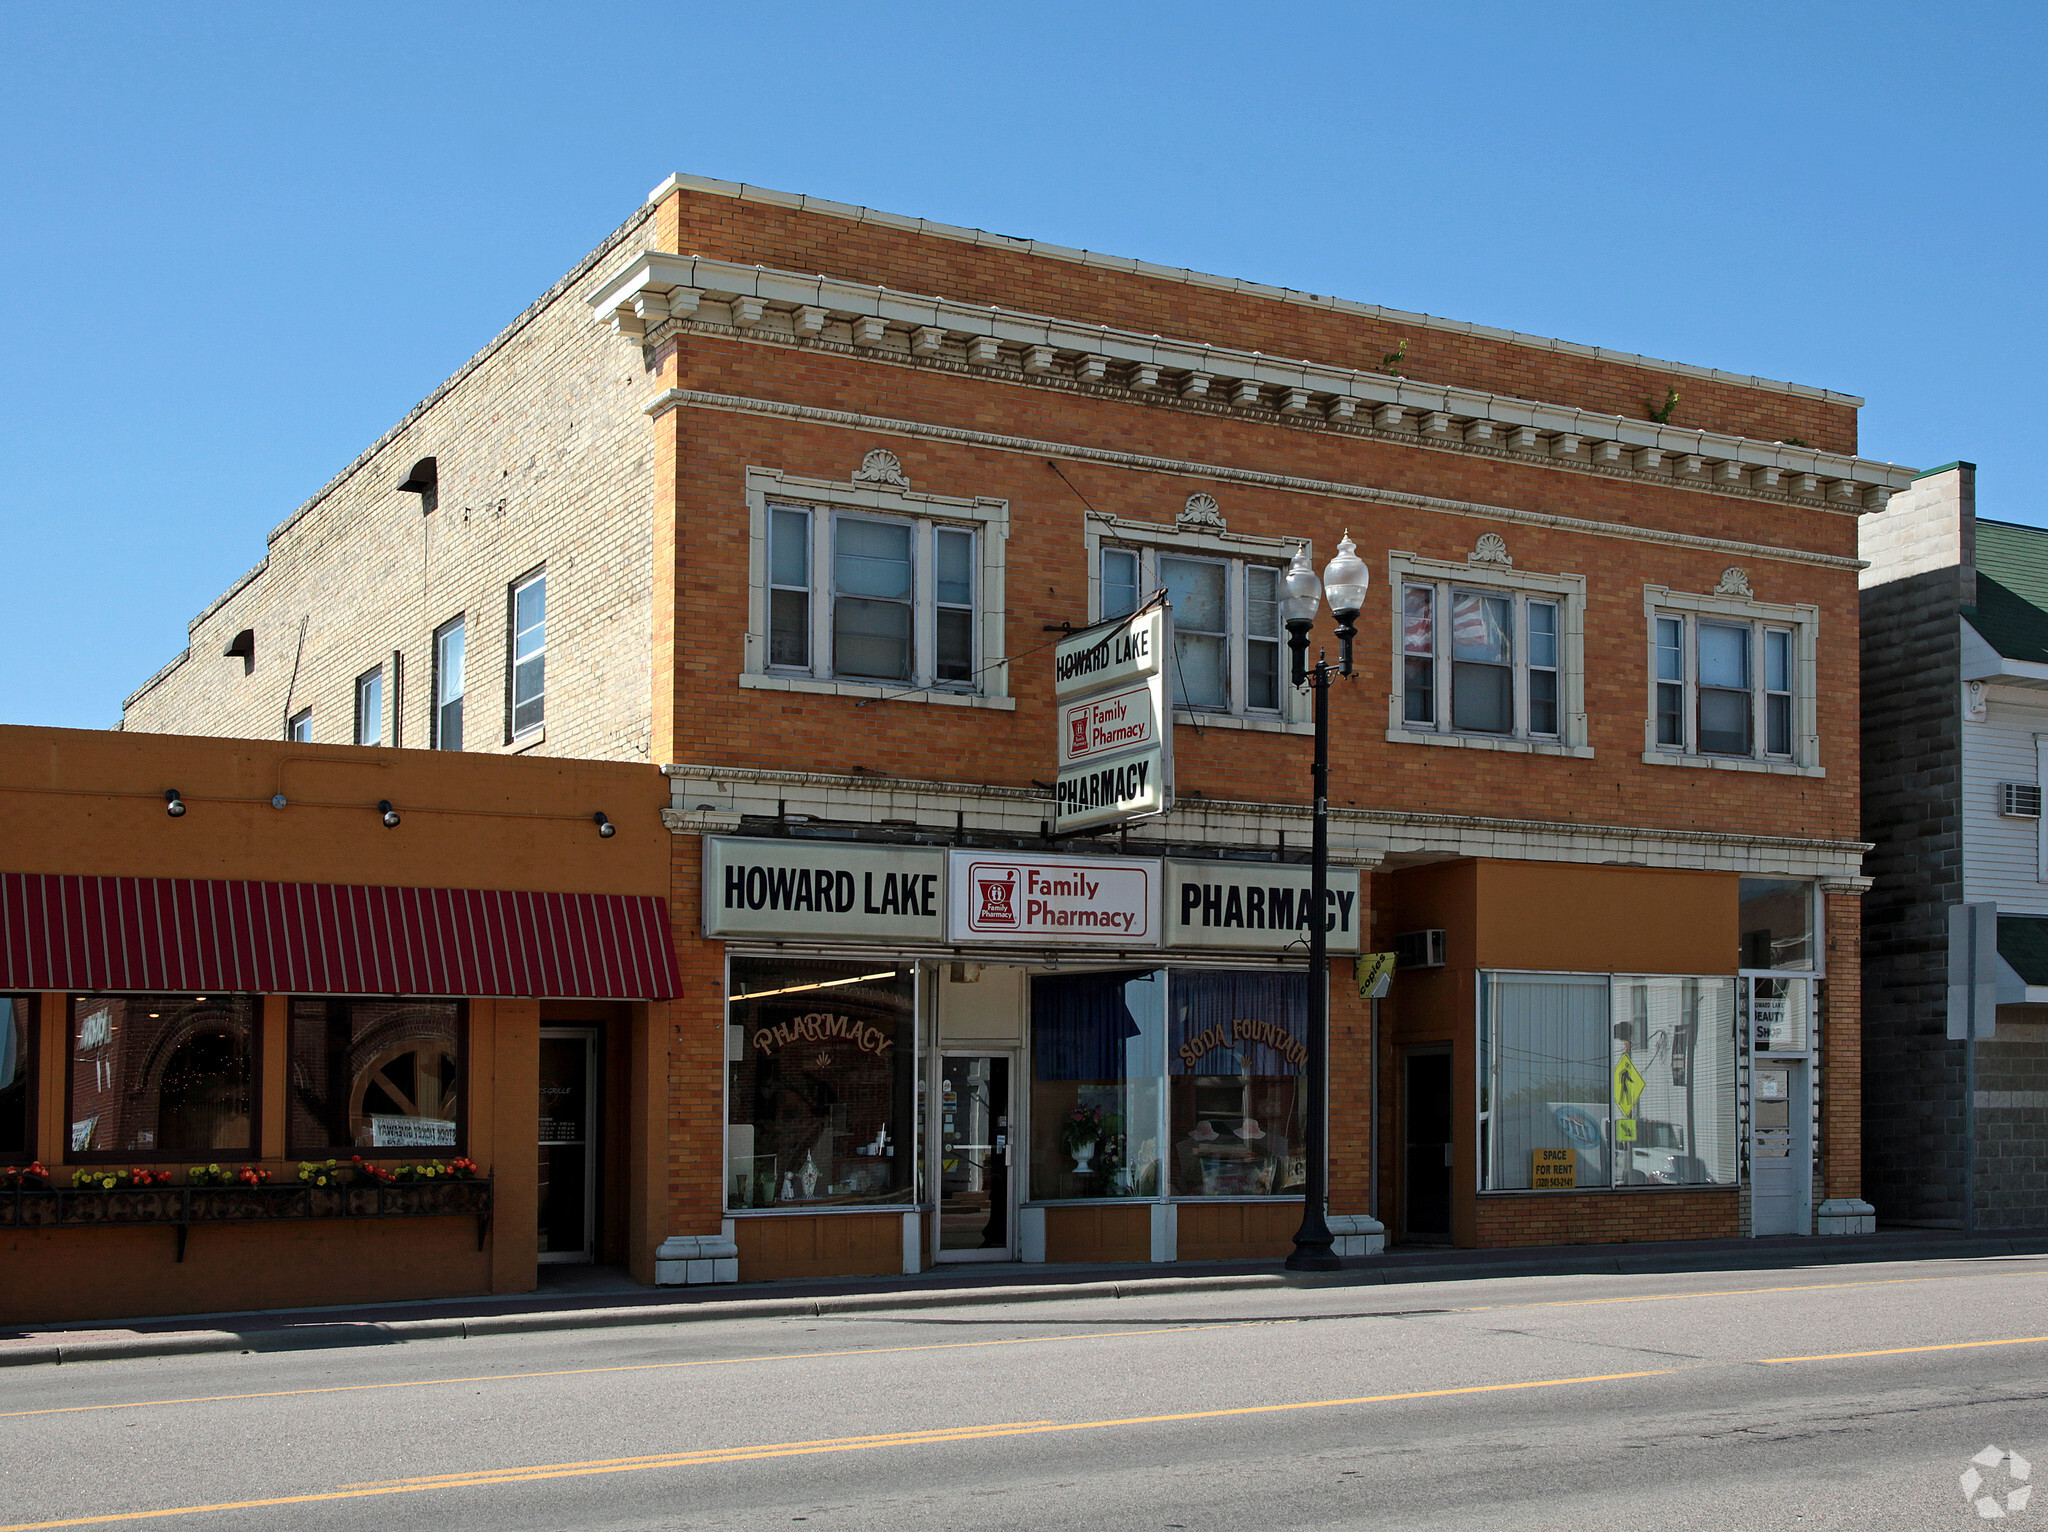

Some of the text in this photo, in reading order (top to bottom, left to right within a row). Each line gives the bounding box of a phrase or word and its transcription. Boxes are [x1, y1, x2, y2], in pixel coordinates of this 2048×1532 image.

[1056, 630, 1149, 682] HOWARD LAKE
[1092, 700, 1128, 725] Family
[1092, 722, 1145, 747] Pharmacy
[1058, 760, 1149, 817] PHARMACY
[724, 865, 938, 916] HOWARD LAKE
[1027, 869, 1100, 900] Family
[981, 909, 1013, 919] Pharmacy
[987, 903, 1008, 912] Family
[1026, 899, 1135, 932] Pharmacy
[1180, 883, 1355, 932] PHARMACY
[1360, 954, 1386, 995] copies
[752, 1012, 895, 1057] PHARMACY
[1179, 1019, 1309, 1073] SODA FOUNTAIN
[1536, 1164, 1573, 1175] FOR RENT
[1543, 1150, 1567, 1160] SPACE
